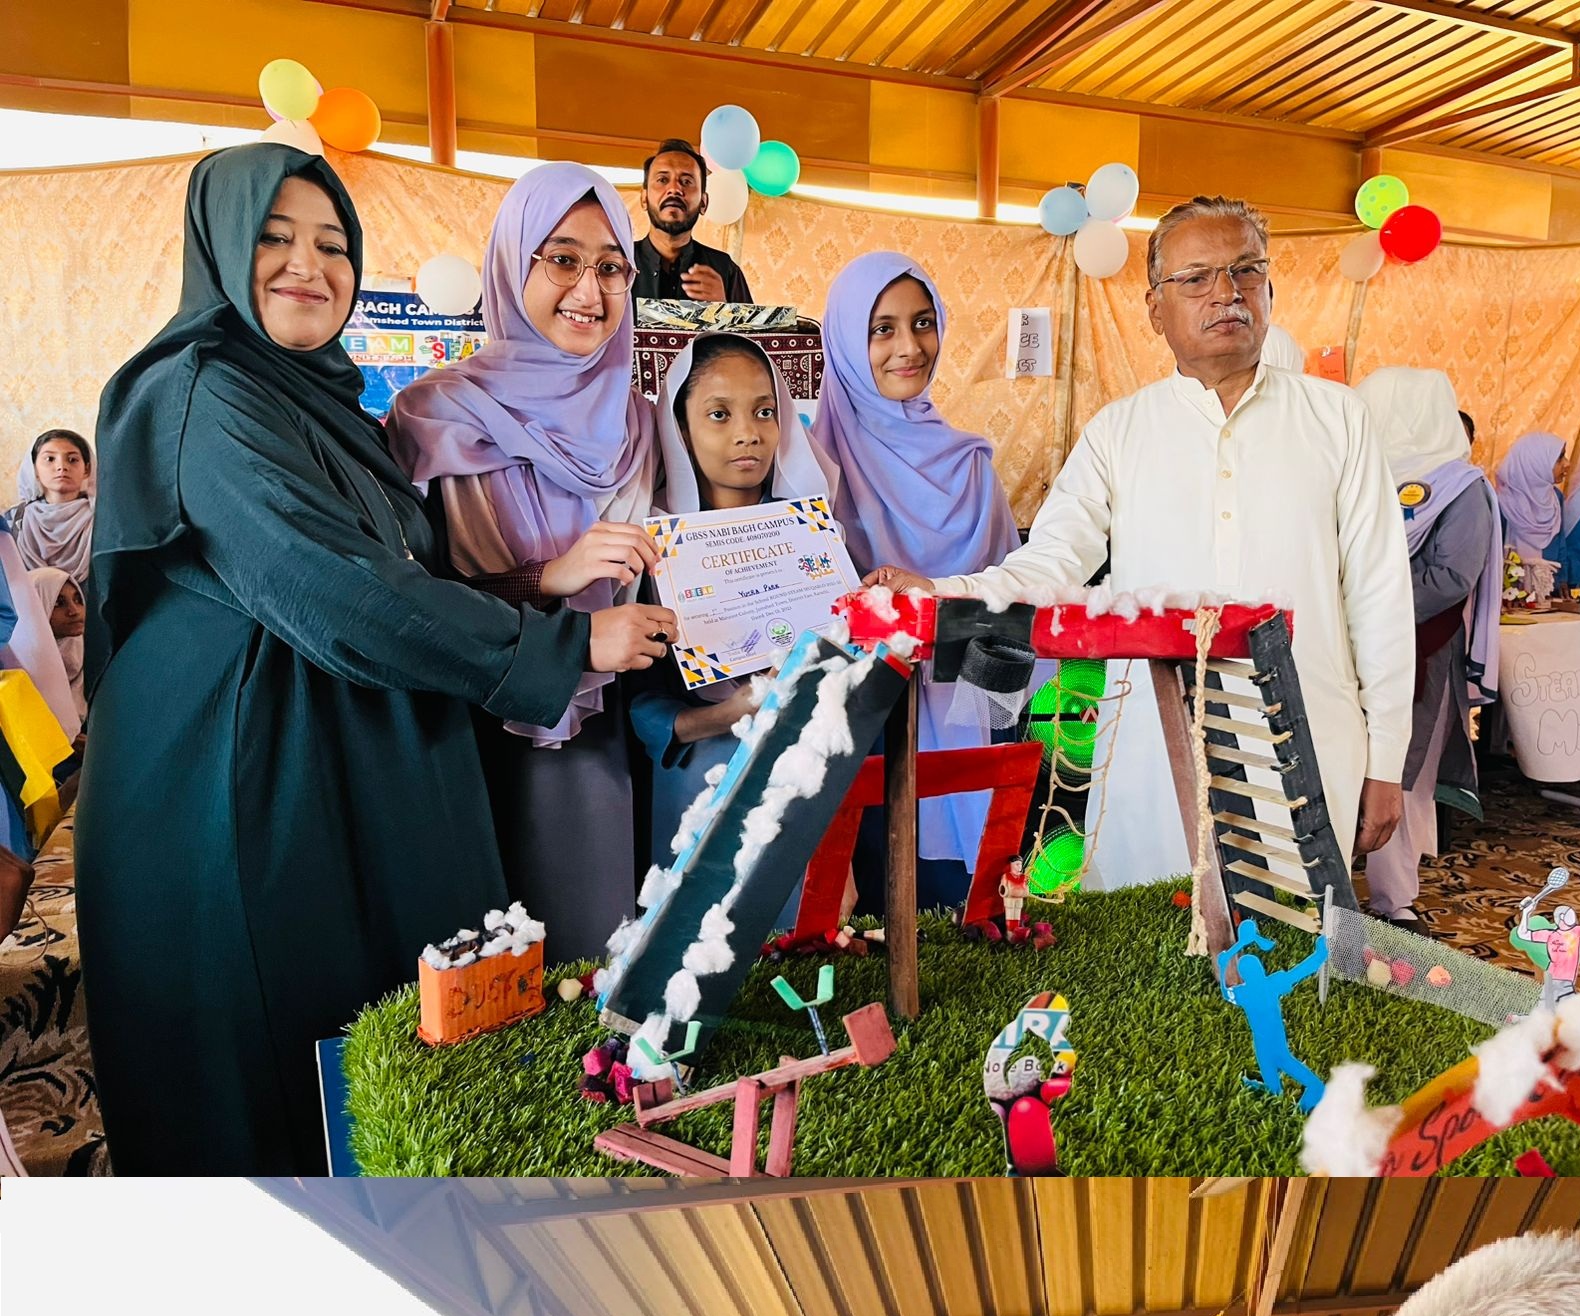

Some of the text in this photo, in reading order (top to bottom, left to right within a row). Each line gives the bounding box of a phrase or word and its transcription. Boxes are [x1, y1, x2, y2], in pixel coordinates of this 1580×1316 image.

[444, 319, 484, 327] District
[686, 517, 795, 541] GBSS NABI BAGH CAMPUS
[701, 542, 796, 570] CERTIFICATE
[734, 560, 778, 575] ACHIEVEMENT
